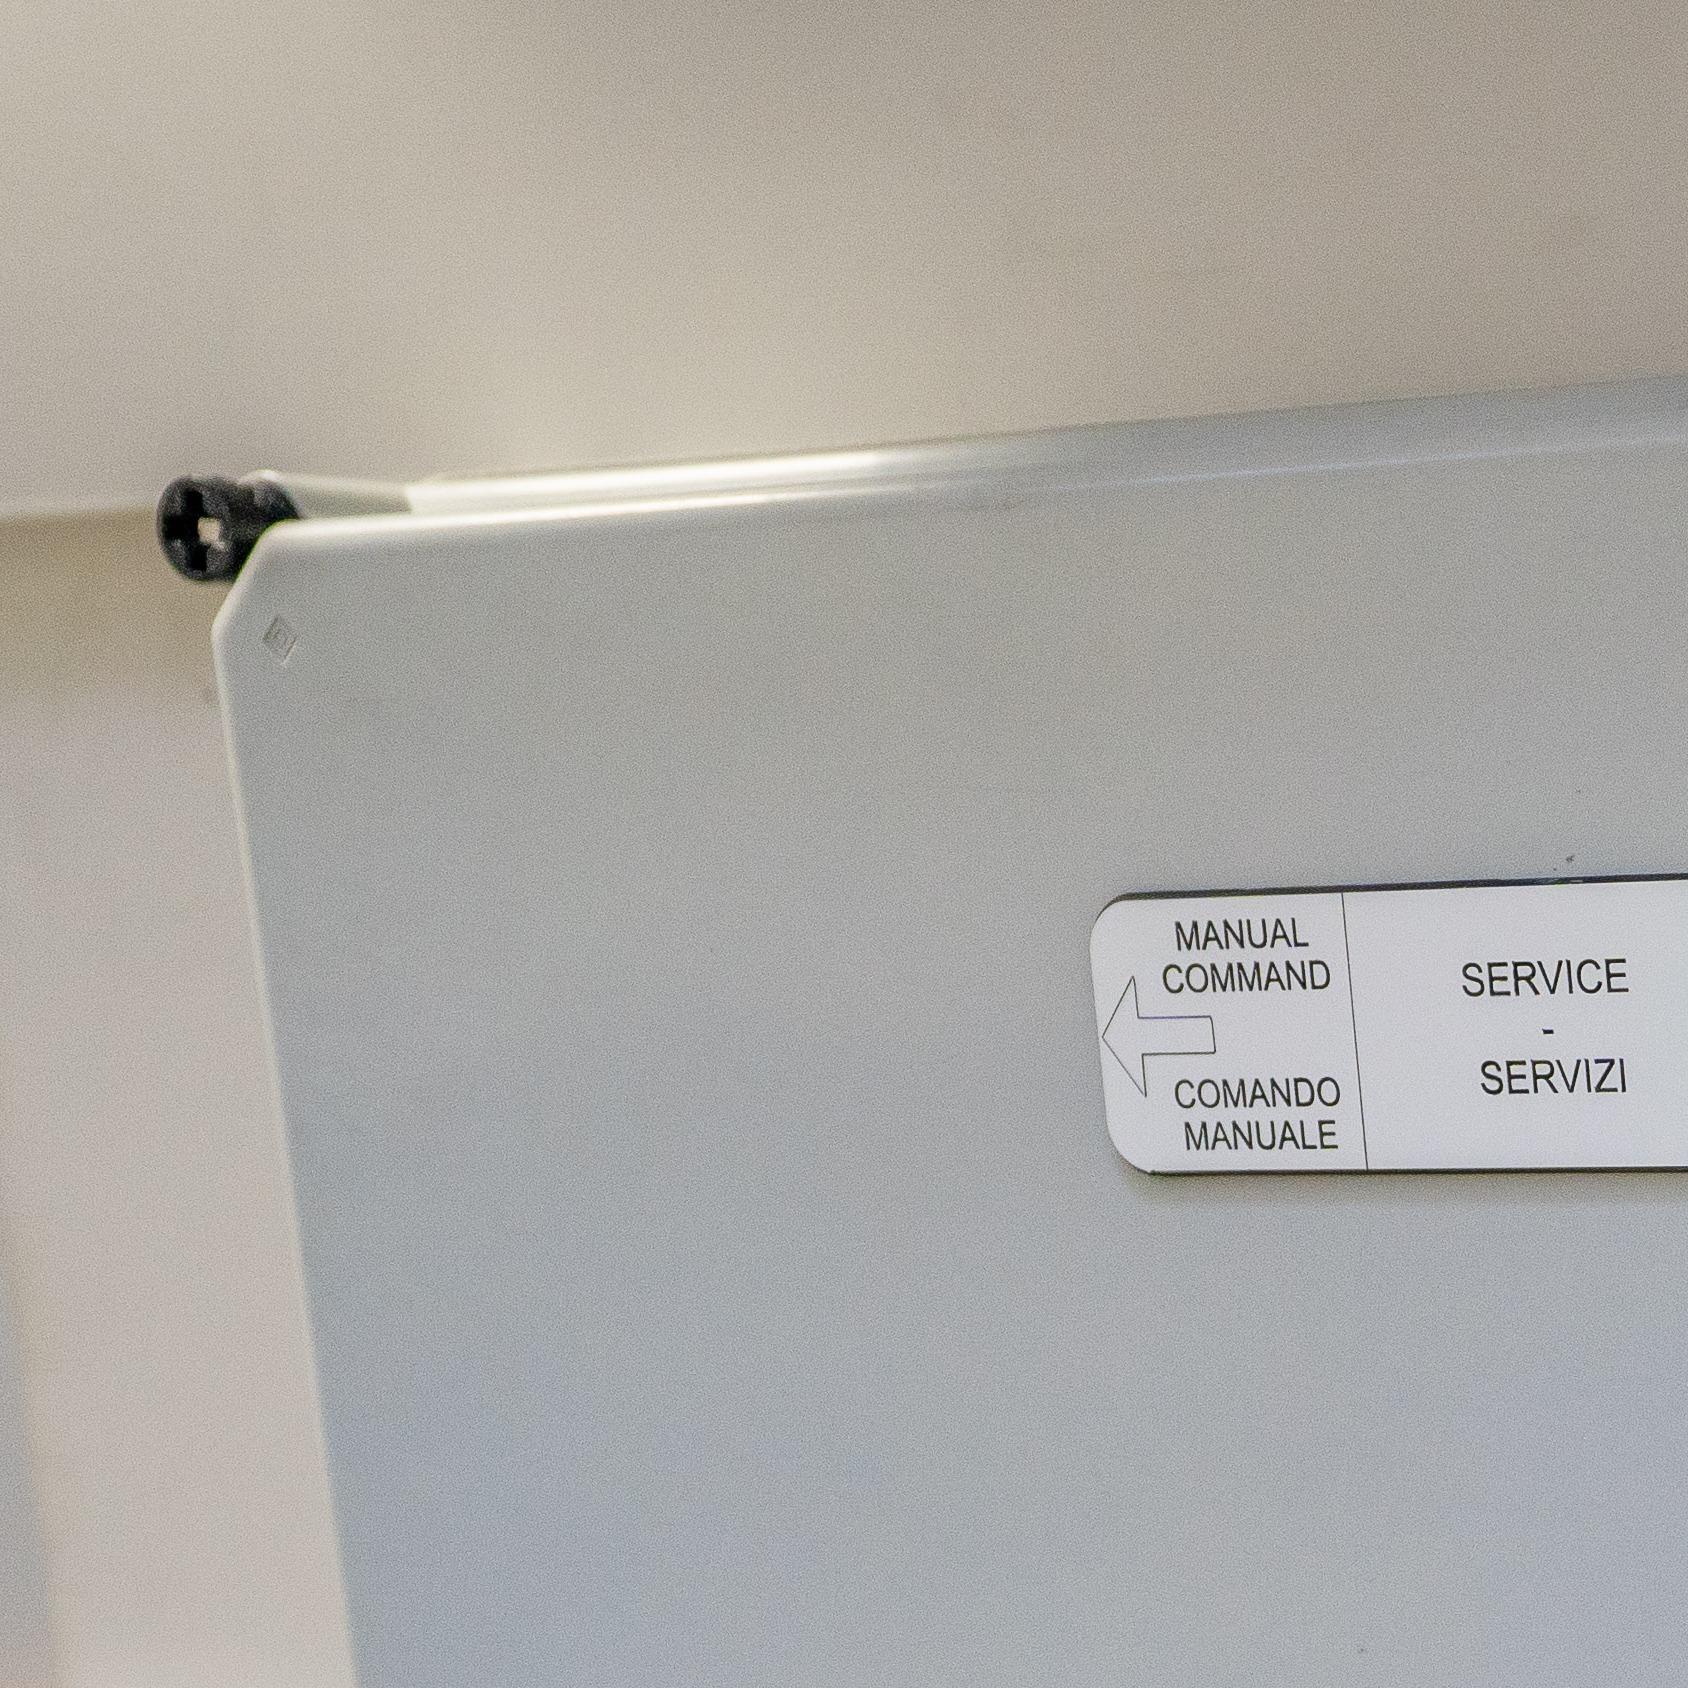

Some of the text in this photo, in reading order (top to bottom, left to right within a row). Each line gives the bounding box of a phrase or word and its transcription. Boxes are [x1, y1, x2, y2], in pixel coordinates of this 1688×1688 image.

[1174, 916, 1310, 952] MANUAL
[1161, 958, 1332, 995] COMMAND
[1461, 957, 1630, 999] SERVICE
[1173, 1075, 1342, 1110] COMANDO
[1479, 1057, 1628, 1097] SERVIZI
[1183, 1118, 1340, 1152] MANUALE
